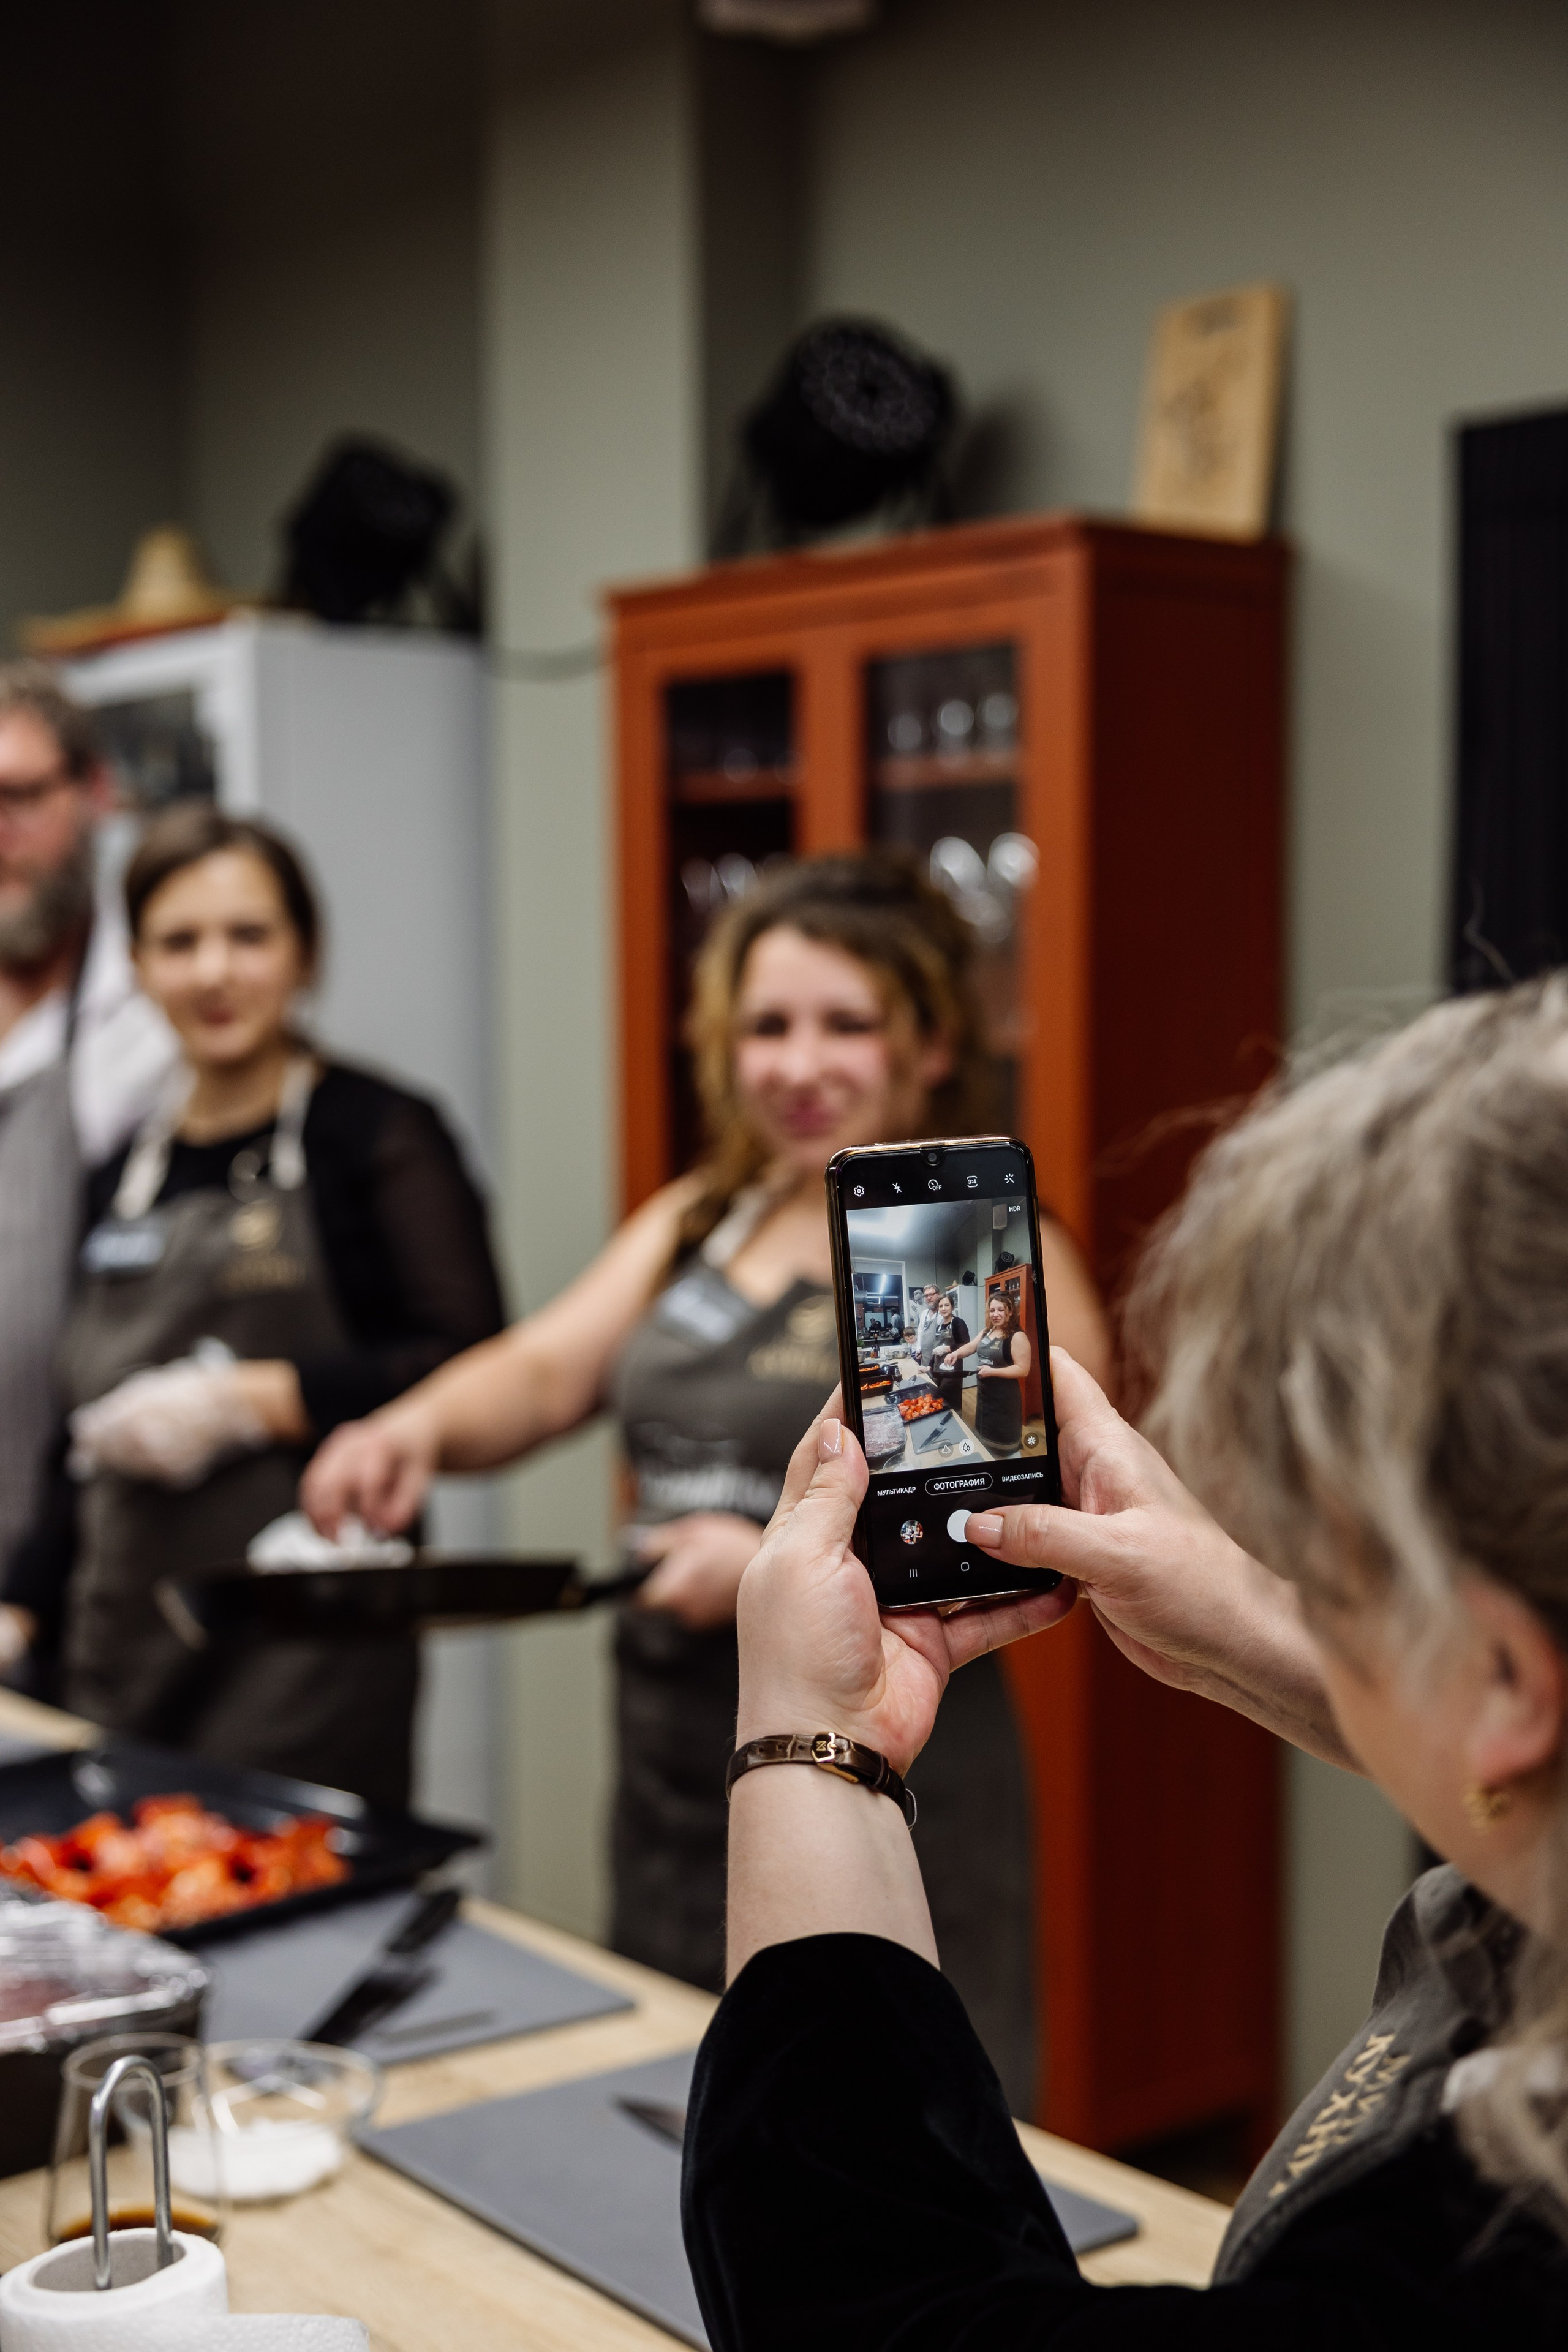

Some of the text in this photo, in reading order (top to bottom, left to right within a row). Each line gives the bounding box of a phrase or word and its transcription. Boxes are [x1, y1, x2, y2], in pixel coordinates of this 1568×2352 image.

[1001, 1472, 1044, 1482] ВИДЕОЗАПИСЬ
[933, 1477, 985, 1491] ФОТОГРАФИЯ
[877, 1487, 916, 1496] МУЛЬТИКАДР
